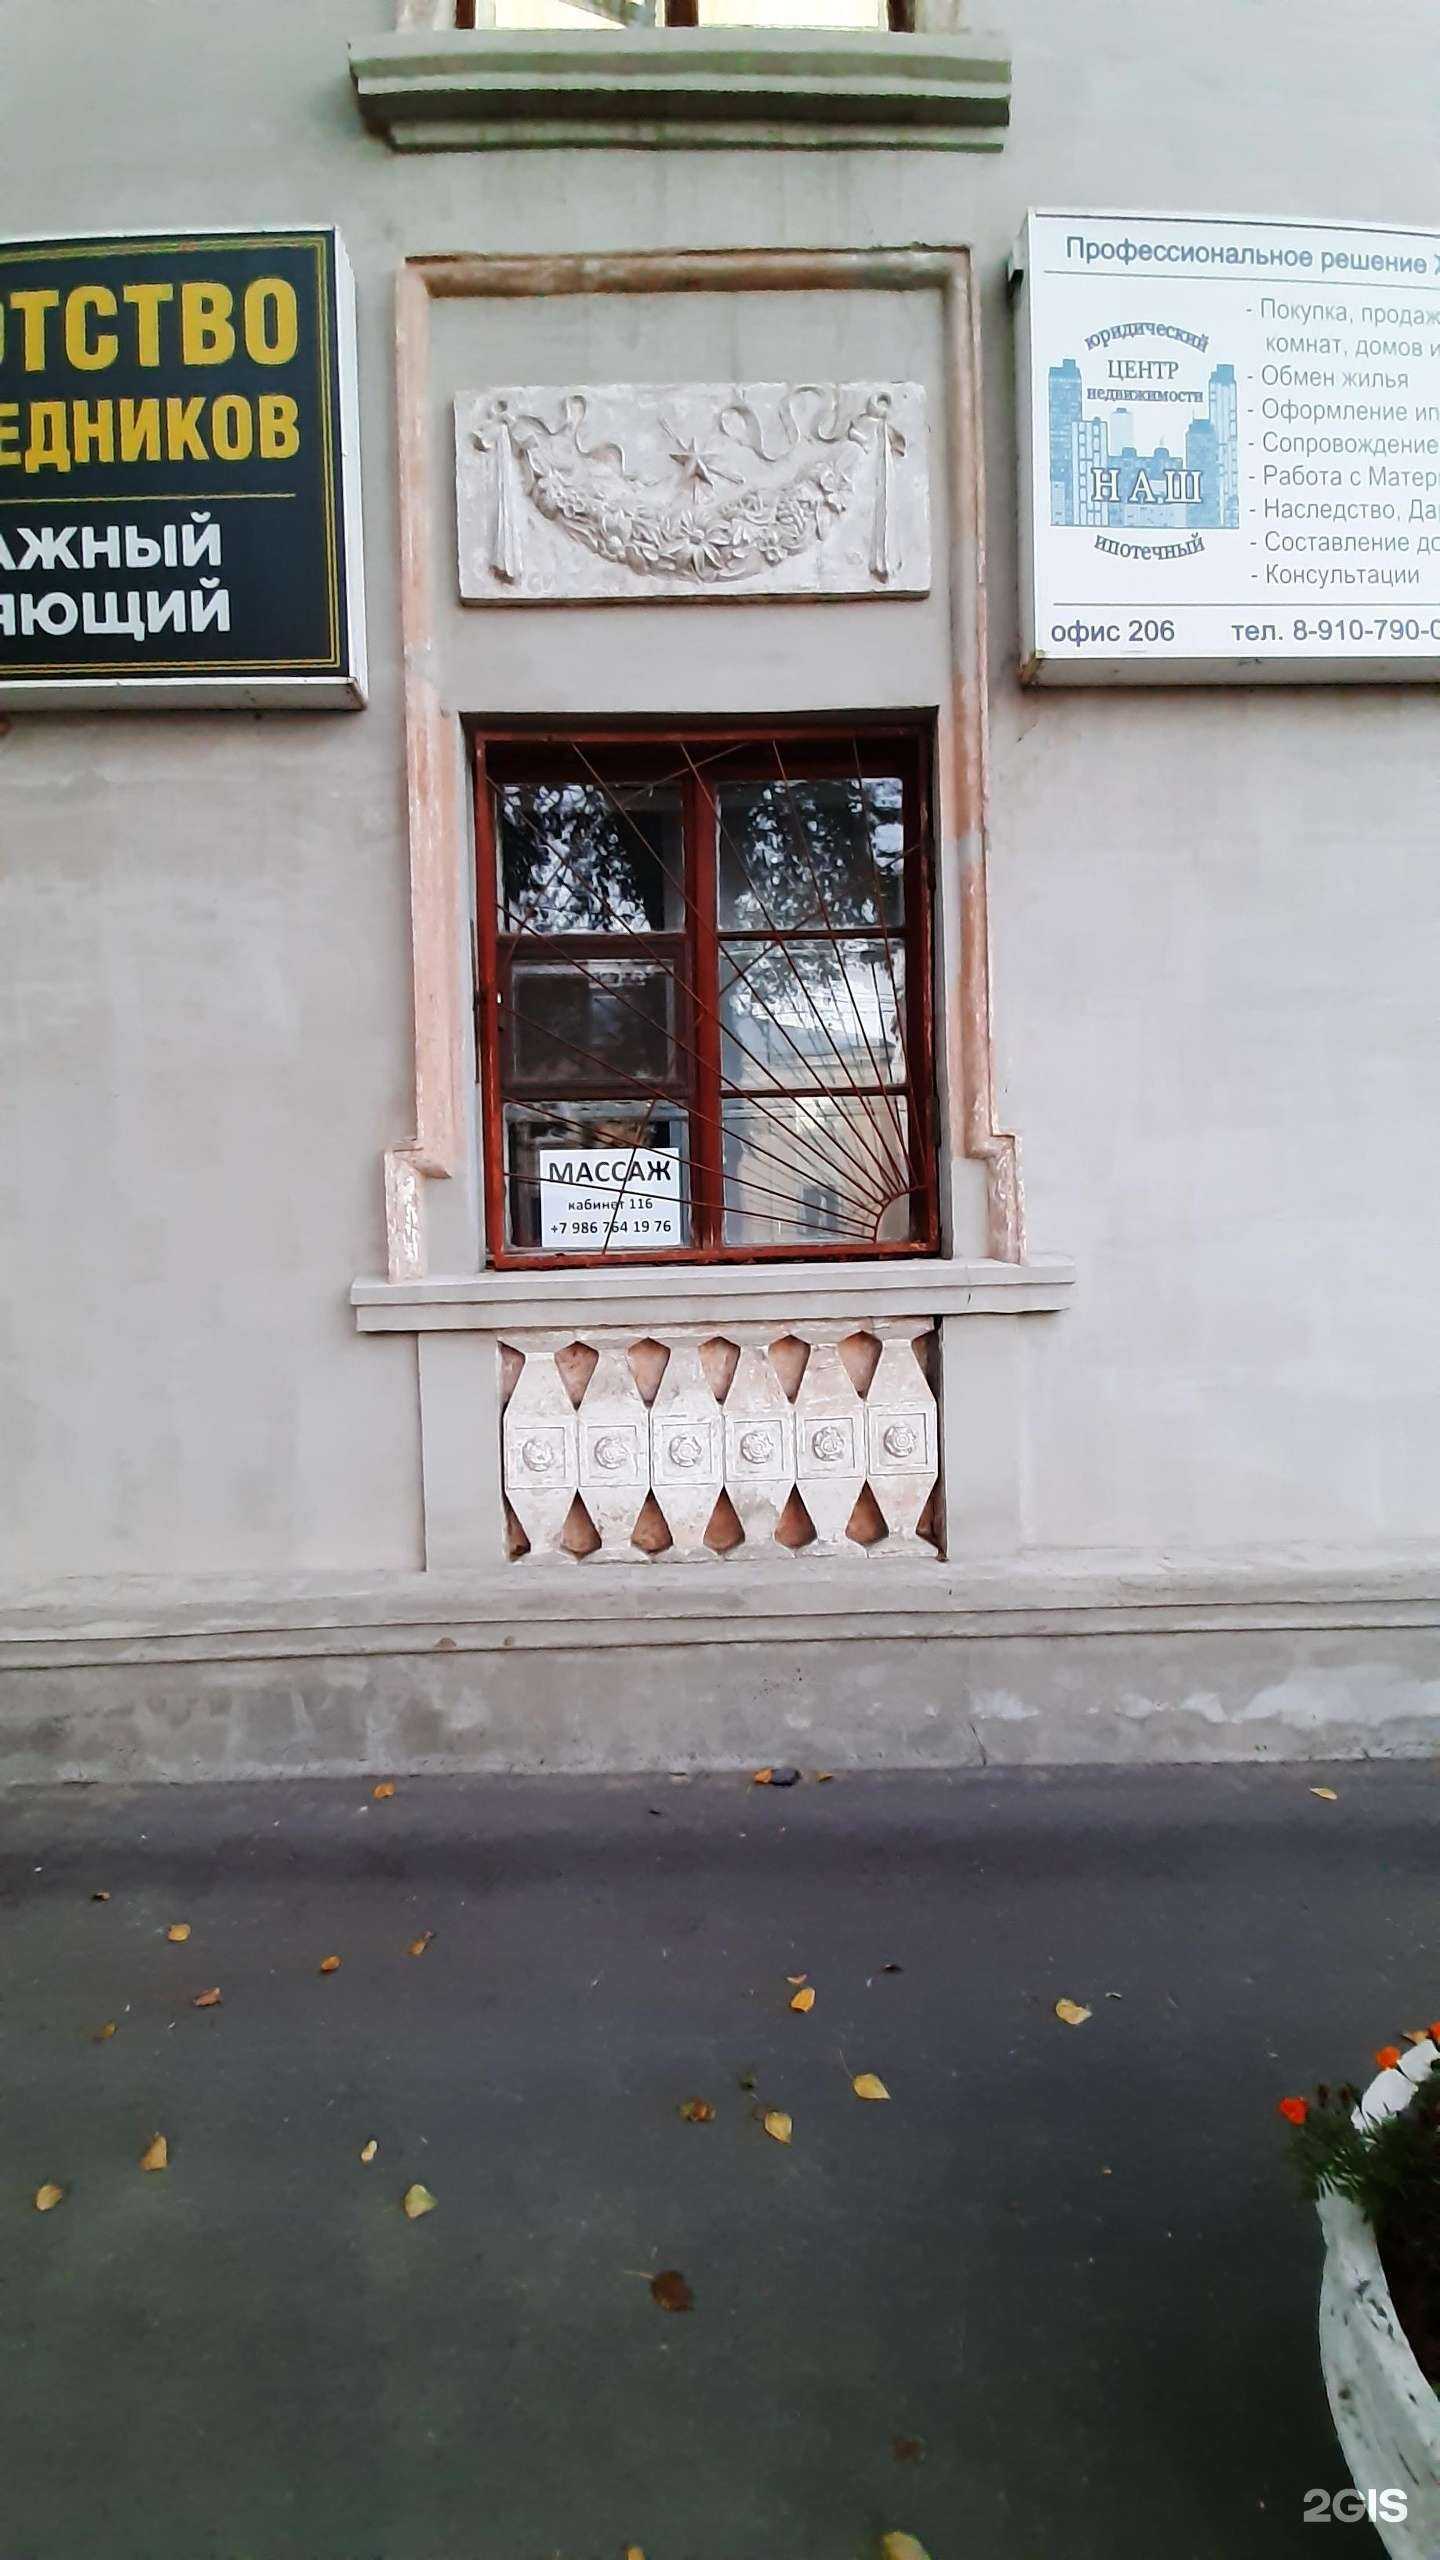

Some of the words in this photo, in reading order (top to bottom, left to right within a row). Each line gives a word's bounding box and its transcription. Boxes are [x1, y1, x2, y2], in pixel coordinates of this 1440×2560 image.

[1066, 236, 1313, 268] Профессиональное
[1320, 252, 1427, 274] решение
[1260, 297, 1354, 325] Покупка,
[0, 278, 298, 371] ТСТВО
[1084, 321, 1210, 354] юридический
[1265, 334, 1349, 356] комнат,
[1355, 338, 1424, 358] домов
[1107, 358, 1180, 381] ЦЕНТР
[1261, 364, 1335, 388] Обмен
[1341, 371, 1409, 389] жилья
[1086, 387, 1204, 403] недвижимости
[1261, 397, 1408, 424] Оформление
[1262, 430, 1438, 458] Сопровождение
[1262, 464, 1341, 487] Работа
[1350, 470, 1361, 487] с
[1368, 464, 1440, 491] Матер
[1263, 497, 1401, 523] Наследство,
[1409, 497, 1440, 523] Да
[1093, 532, 1206, 561] ипотечный
[1264, 530, 1410, 553] Составление
[1265, 564, 1420, 588] Консультации
[1051, 619, 1121, 648] офис
[1128, 619, 1176, 643] 206
[1231, 624, 1283, 643] тел.
[549, 1160, 672, 1183] МАССАЖ
[568, 1198, 625, 1211] кабинет
[629, 1198, 653, 1210] 116
[550, 1222, 567, 1234] +7
[572, 1222, 598, 1234] 986
[602, 1221, 628, 1234] 764
[633, 1220, 650, 1233] 19
[654, 1220, 672, 1233] 76
